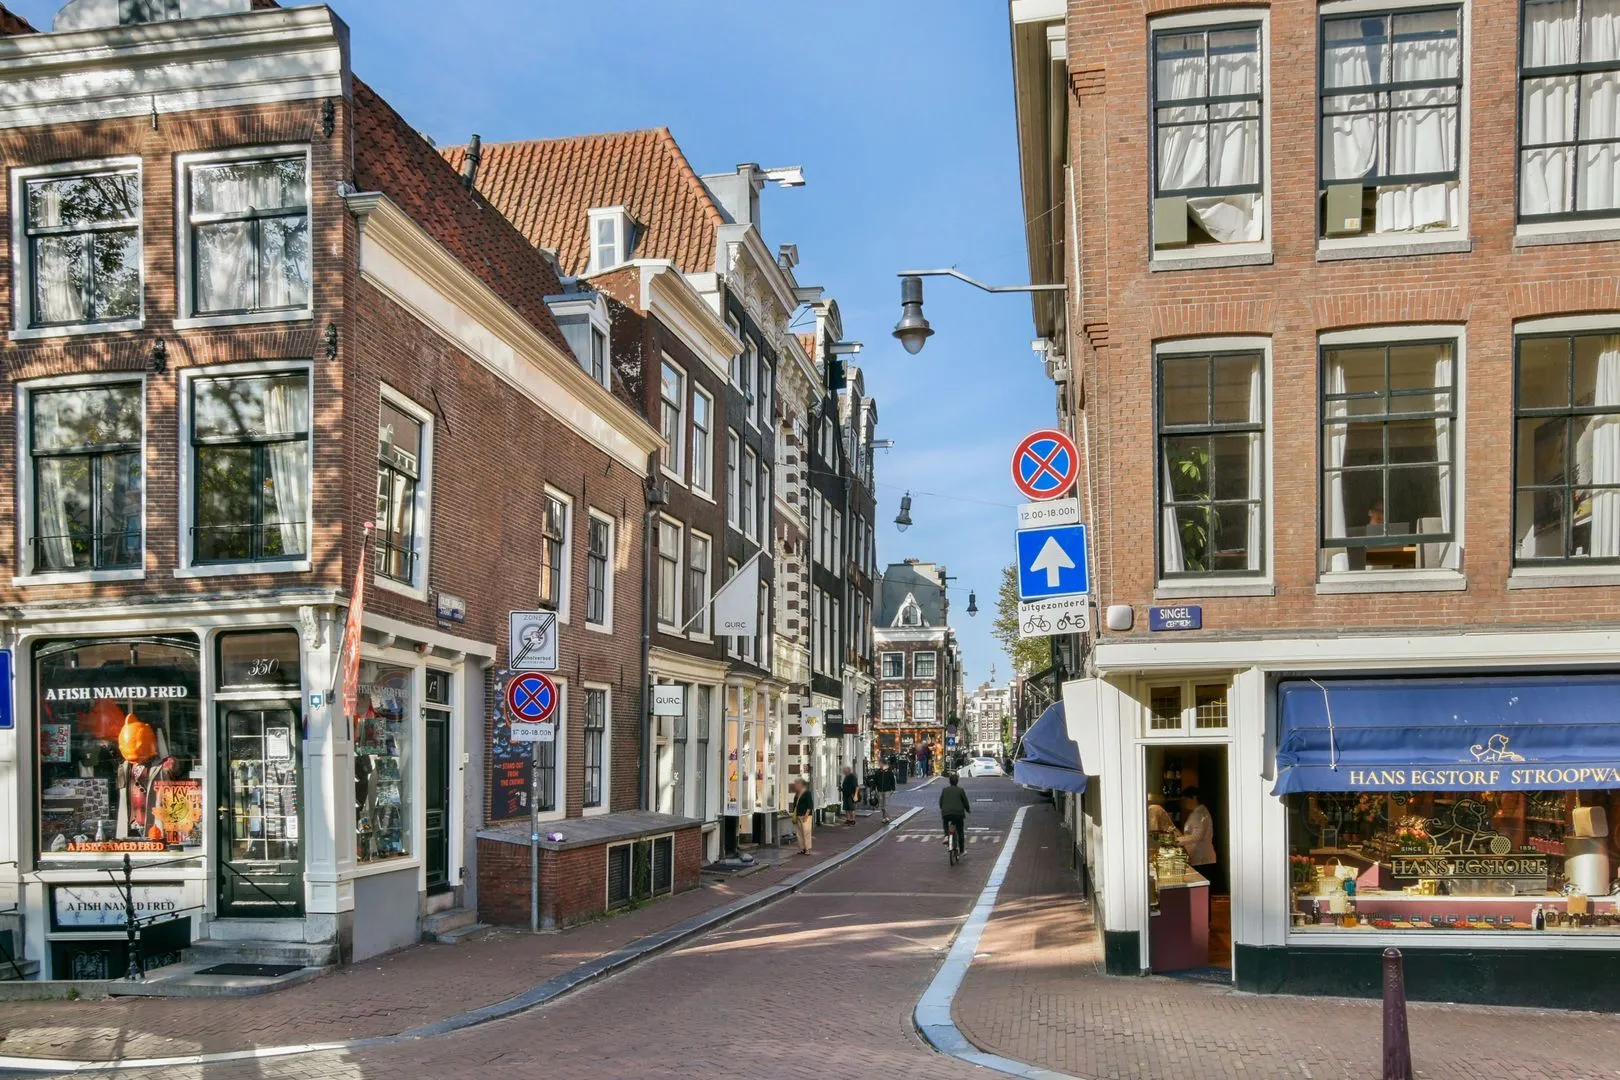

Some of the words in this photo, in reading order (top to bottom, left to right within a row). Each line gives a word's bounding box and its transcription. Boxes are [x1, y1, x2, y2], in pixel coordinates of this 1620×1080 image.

[1020, 507, 1076, 520] 12.00-18.00h
[1021, 599, 1085, 612] uitgezonderd
[1160, 607, 1191, 619] SINGEL
[248, 658, 280, 676] 350
[46, 688, 57, 700] A
[58, 687, 90, 700] FISH
[93, 686, 147, 699] NAMED
[149, 685, 188, 698] FRED
[1349, 770, 1405, 785] HANS
[1411, 770, 1500, 785] EGSTORF
[1511, 768, 1620, 785] STROOPWA
[67, 842, 75, 851] A
[76, 842, 99, 851] FISH
[100, 842, 137, 851] NAMED
[138, 842, 164, 851] FRED
[1391, 859, 1449, 875] HANS
[1455, 859, 1547, 875] EGSTORF
[67, 902, 75, 911] A
[78, 902, 101, 911] FISH
[104, 902, 144, 911] NAMD
[145, 902, 175, 911] FRED
